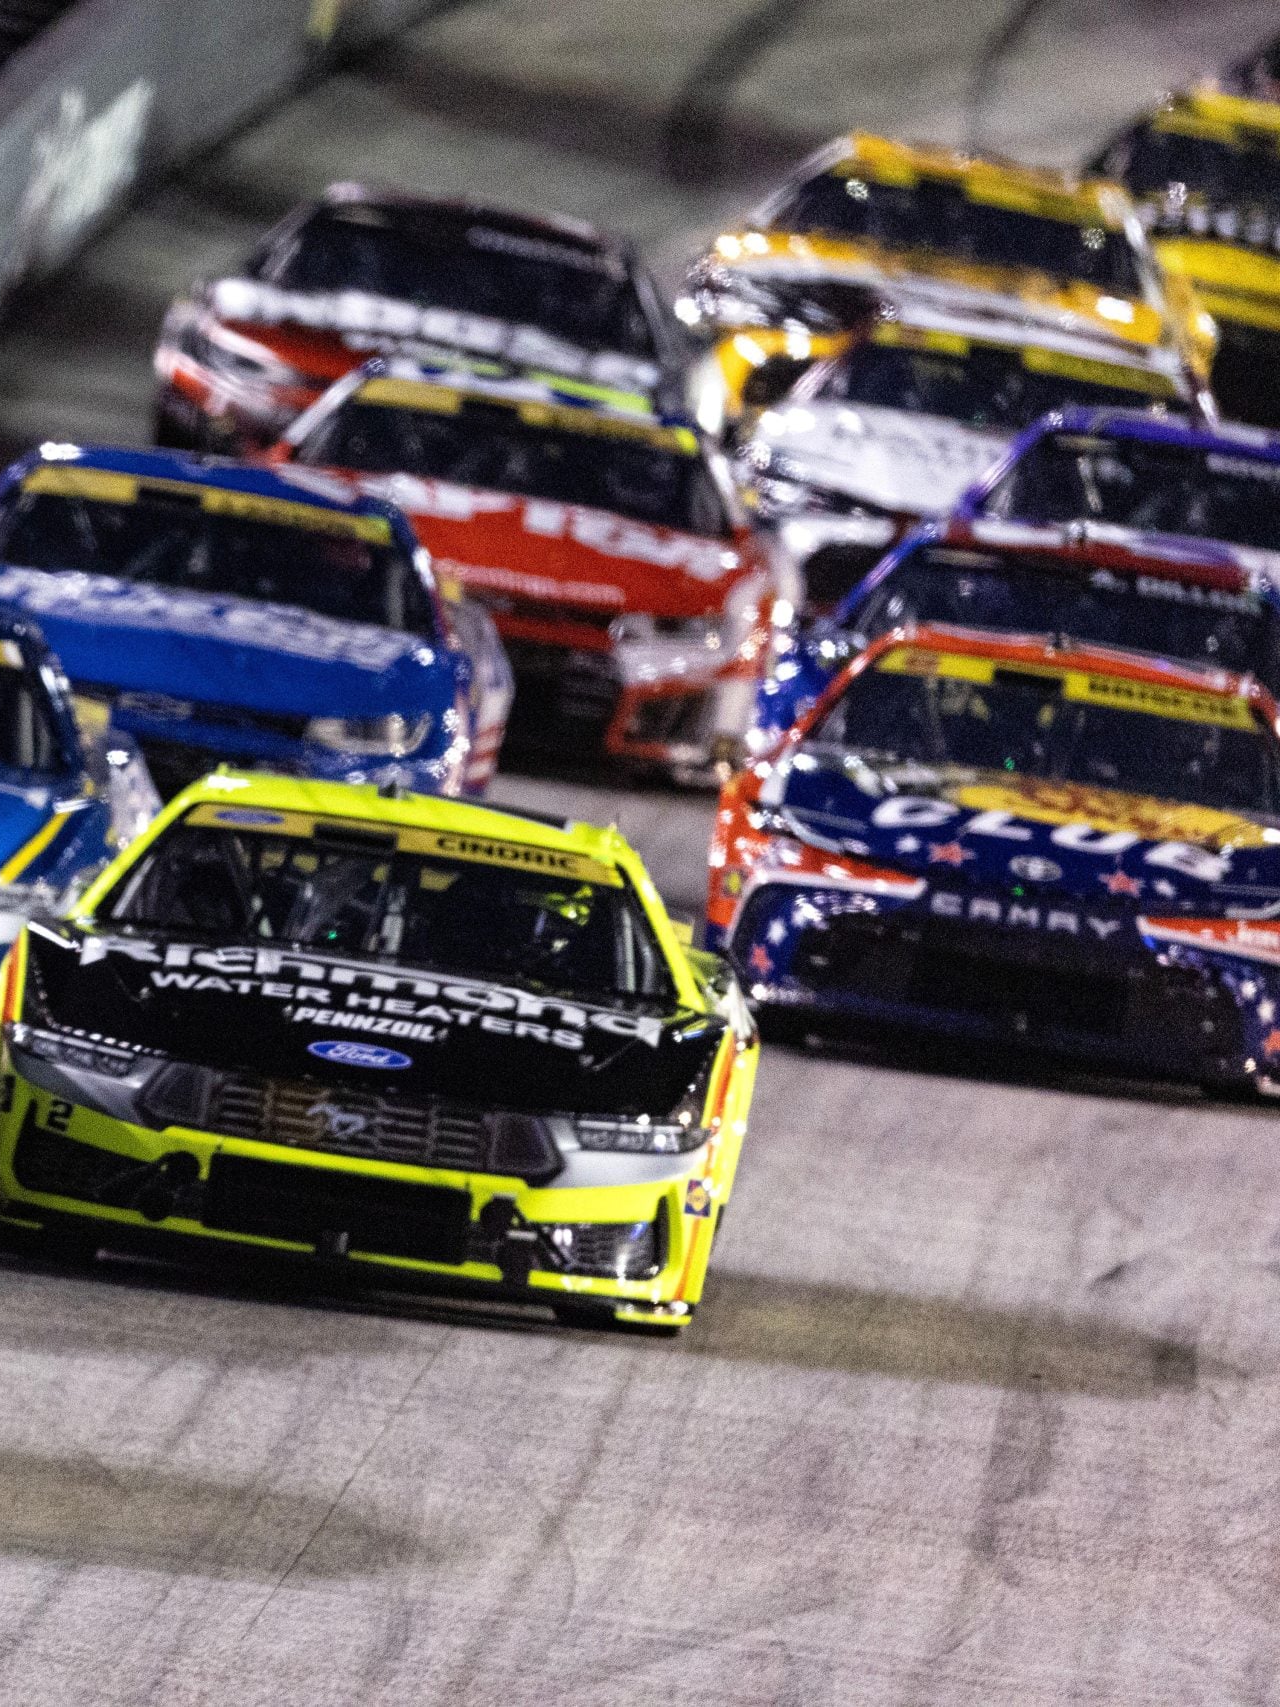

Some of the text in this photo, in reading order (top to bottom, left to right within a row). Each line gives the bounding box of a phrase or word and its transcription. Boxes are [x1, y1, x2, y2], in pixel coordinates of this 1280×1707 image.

[436, 836, 579, 872] CINDRIC
[80, 936, 663, 1048] Richmond
[150, 971, 585, 1051] WATER HEATERS
[292, 1006, 437, 1042] PENNZOIL
